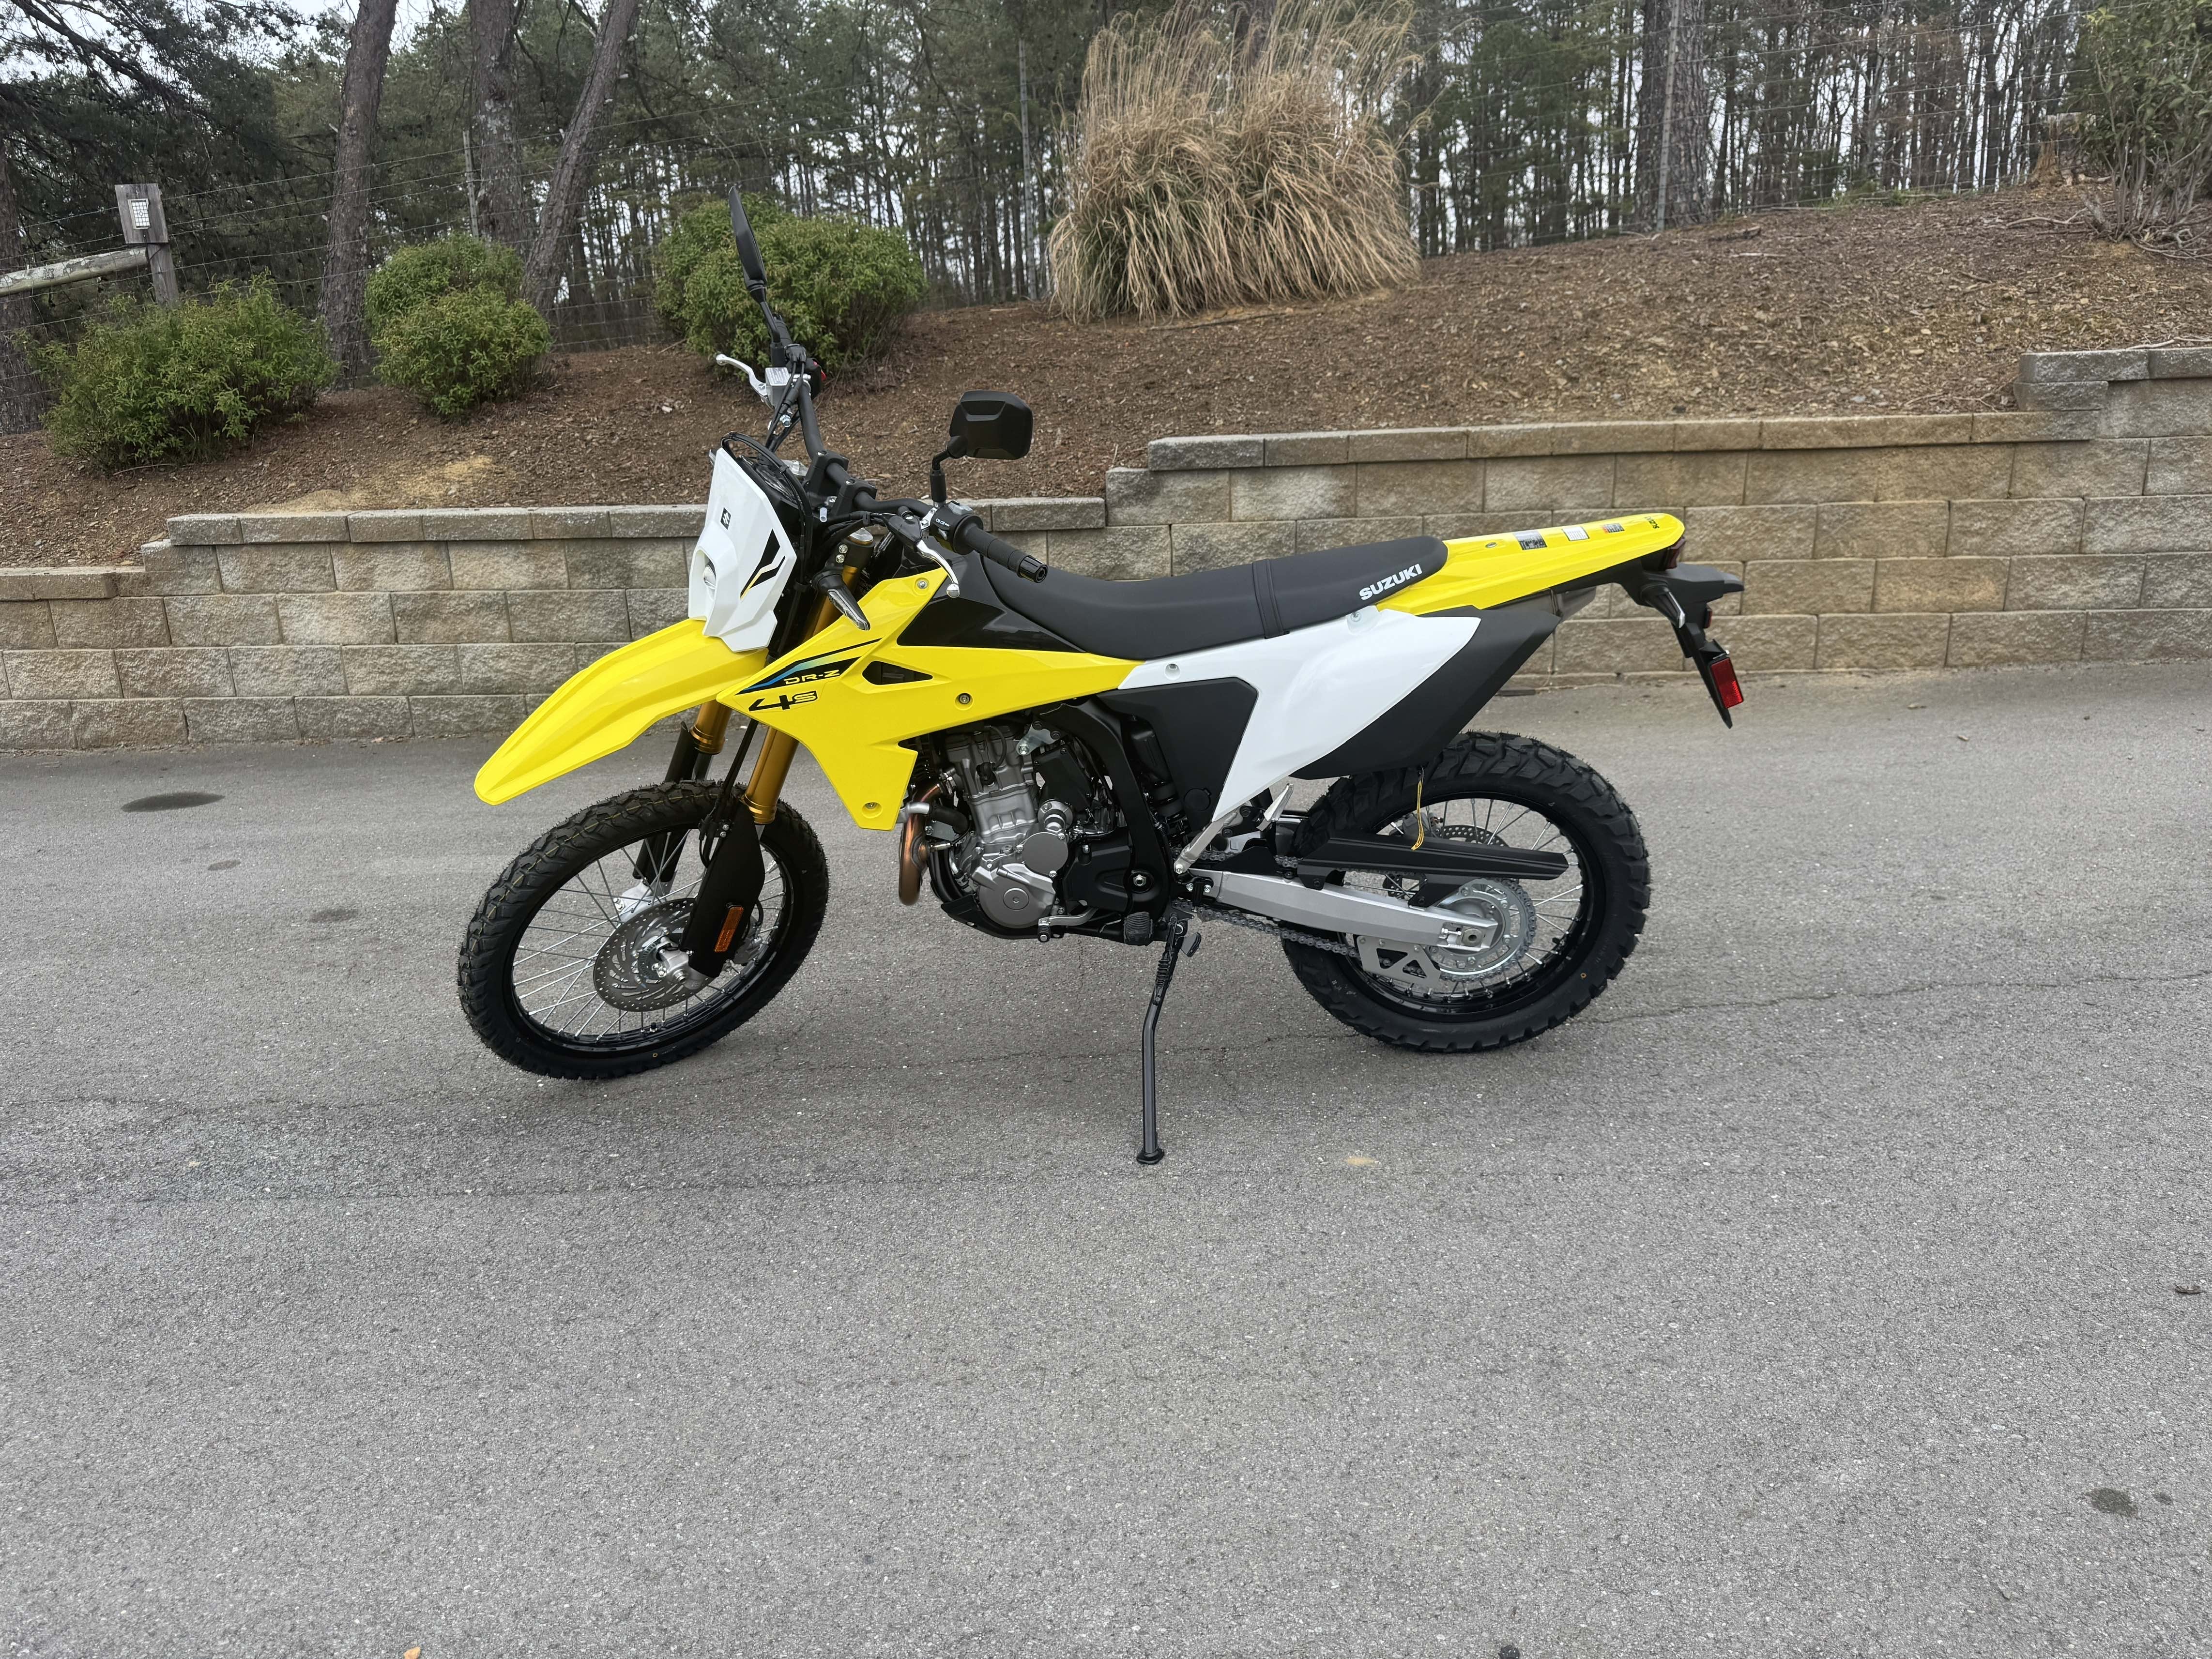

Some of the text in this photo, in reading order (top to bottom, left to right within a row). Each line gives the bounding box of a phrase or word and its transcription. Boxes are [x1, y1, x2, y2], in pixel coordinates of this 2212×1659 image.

[1359, 563, 1422, 600] SUZUKI
[783, 670, 840, 685] DR-Z
[748, 690, 818, 712] 4S
